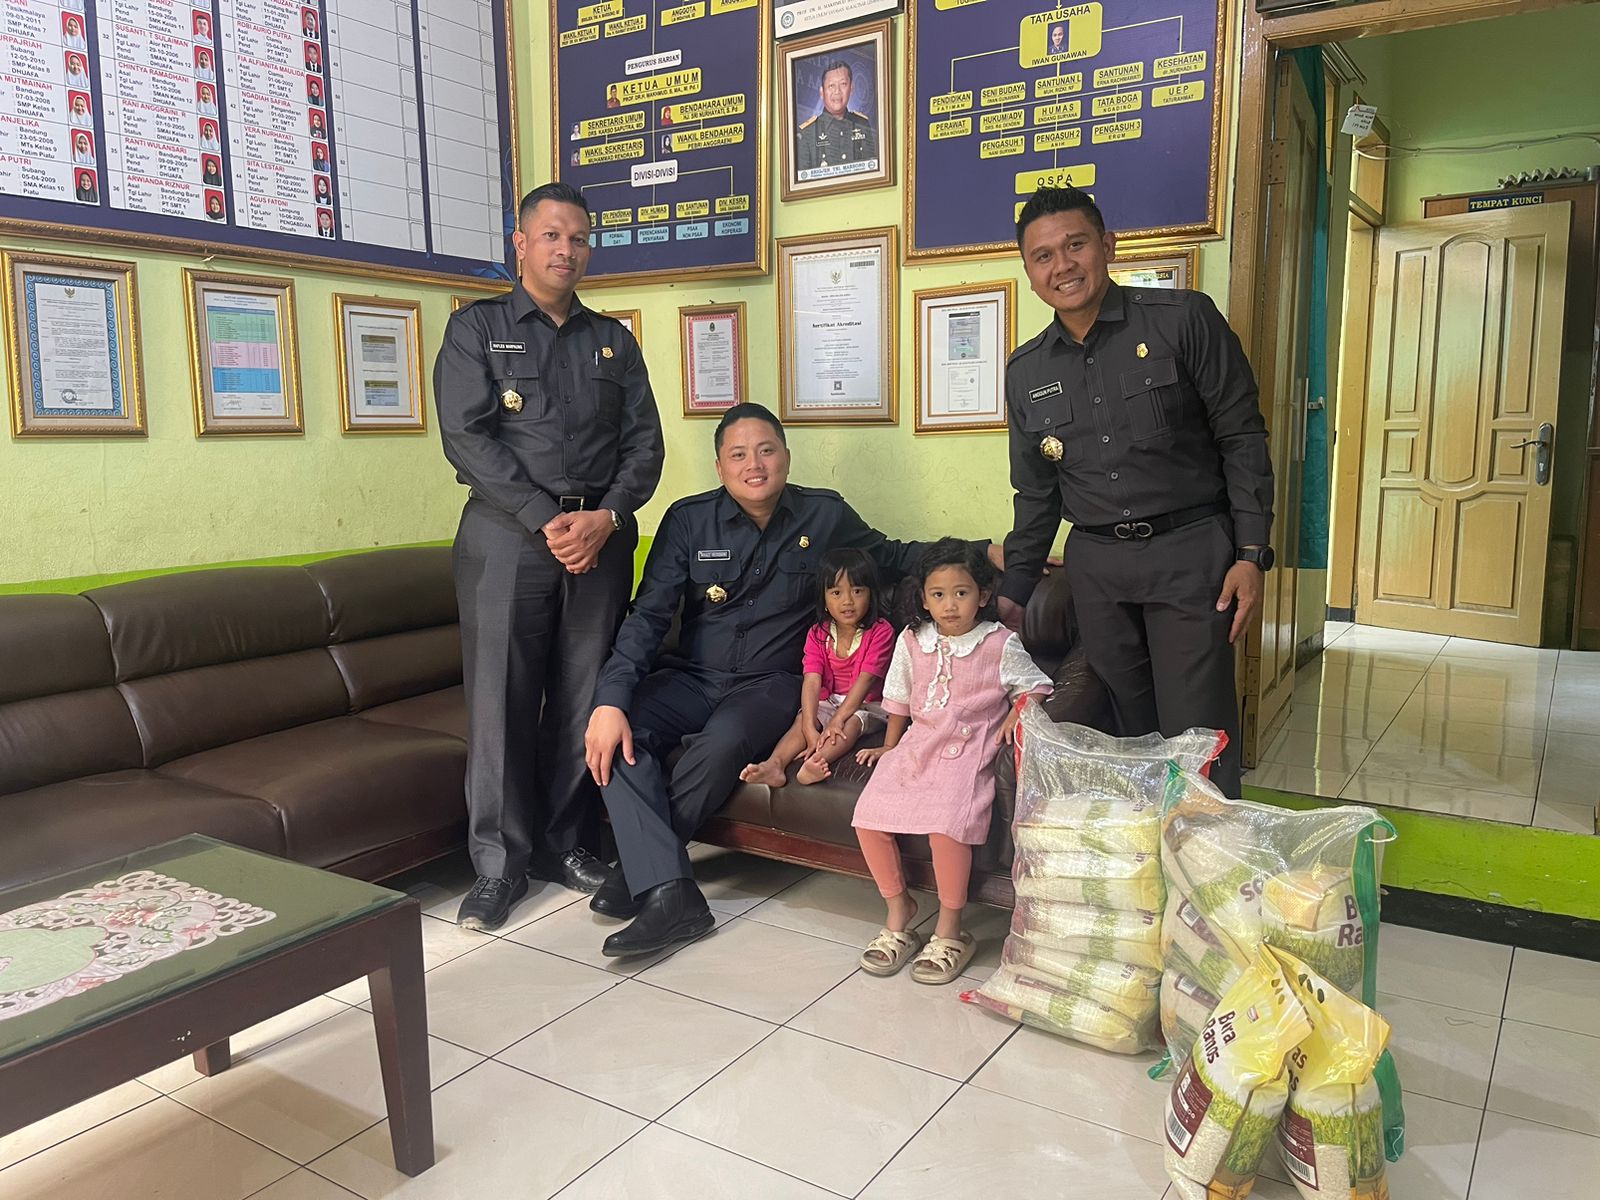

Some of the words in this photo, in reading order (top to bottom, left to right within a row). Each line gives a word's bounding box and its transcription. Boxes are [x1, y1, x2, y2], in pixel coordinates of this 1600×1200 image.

[593, 4, 612, 14] KETUA
[672, 6, 696, 16] ANGGOTA
[1030, 13, 1054, 25] TATA
[1056, 5, 1091, 19] USAHA
[24, 24, 41, 32] Kelas
[609, 22, 624, 30] WAKIL
[624, 18, 640, 27] KETUA
[8, 28, 35, 38] DHUAFA
[115, 24, 146, 36] SUSANTI
[563, 32, 577, 40] WAKIL
[577, 30, 593, 38] KETUA
[10, 45, 35, 56] Subang
[627, 59, 657, 70] PENGURUS
[658, 54, 680, 64] HARIAN
[1032, 57, 1050, 66] IWAN
[1051, 50, 1087, 62] GUNAWAN
[1158, 54, 1204, 69] KESEHATAN
[12, 60, 26, 68] SMP
[28, 64, 45, 73] Kelas
[1098, 65, 1139, 79] SANTUNAN
[12, 68, 39, 78] DHUAFA
[5, 76, 53, 91] MUTMAINAH
[622, 80, 659, 95] KETUA
[666, 72, 699, 86] UMUM
[1038, 77, 1075, 88] SANTUNAN
[16, 86, 45, 97] Bandung
[982, 90, 998, 98] SENI
[998, 84, 1025, 95] BUDAYA
[680, 100, 721, 114] BENDAHARA
[722, 96, 743, 107] UMUM
[932, 94, 971, 105] PENDIDIKAN
[1098, 98, 1115, 107] TATA
[1116, 94, 1138, 103] BOGA
[32, 104, 50, 112] Kelas
[1042, 104, 1074, 115] HUMAS
[0, 116, 40, 128] ANJELIKA
[588, 117, 624, 130] SEKRETARIS
[625, 112, 644, 122] UMUM
[936, 120, 966, 131] PERAWAT
[20, 127, 48, 137] Bandung
[1094, 122, 1135, 135] PENGASUH
[1136, 121, 1141, 129] 3
[677, 132, 699, 143] WAKIL
[700, 126, 743, 140] BENDAHARA
[1036, 132, 1075, 142] PENGASUH
[125, 138, 146, 146] RANTI
[982, 139, 1018, 150] PENGASUH
[34, 144, 53, 152] Kelas
[584, 148, 603, 157] WAKIL
[604, 140, 643, 154] SEKRETARIS
[8, 156, 32, 166] PUTRI
[158, 151, 182, 161] Bandung
[22, 166, 46, 176] Subang
[634, 168, 676, 181] DIVISI-DIVISI
[160, 188, 185, 197] Bandung
[729, 197, 747, 205] KESRA
[1470, 198, 1510, 210] TEMPAT
[1512, 196, 1543, 206] KUNCI
[650, 206, 667, 214] HUMAS
